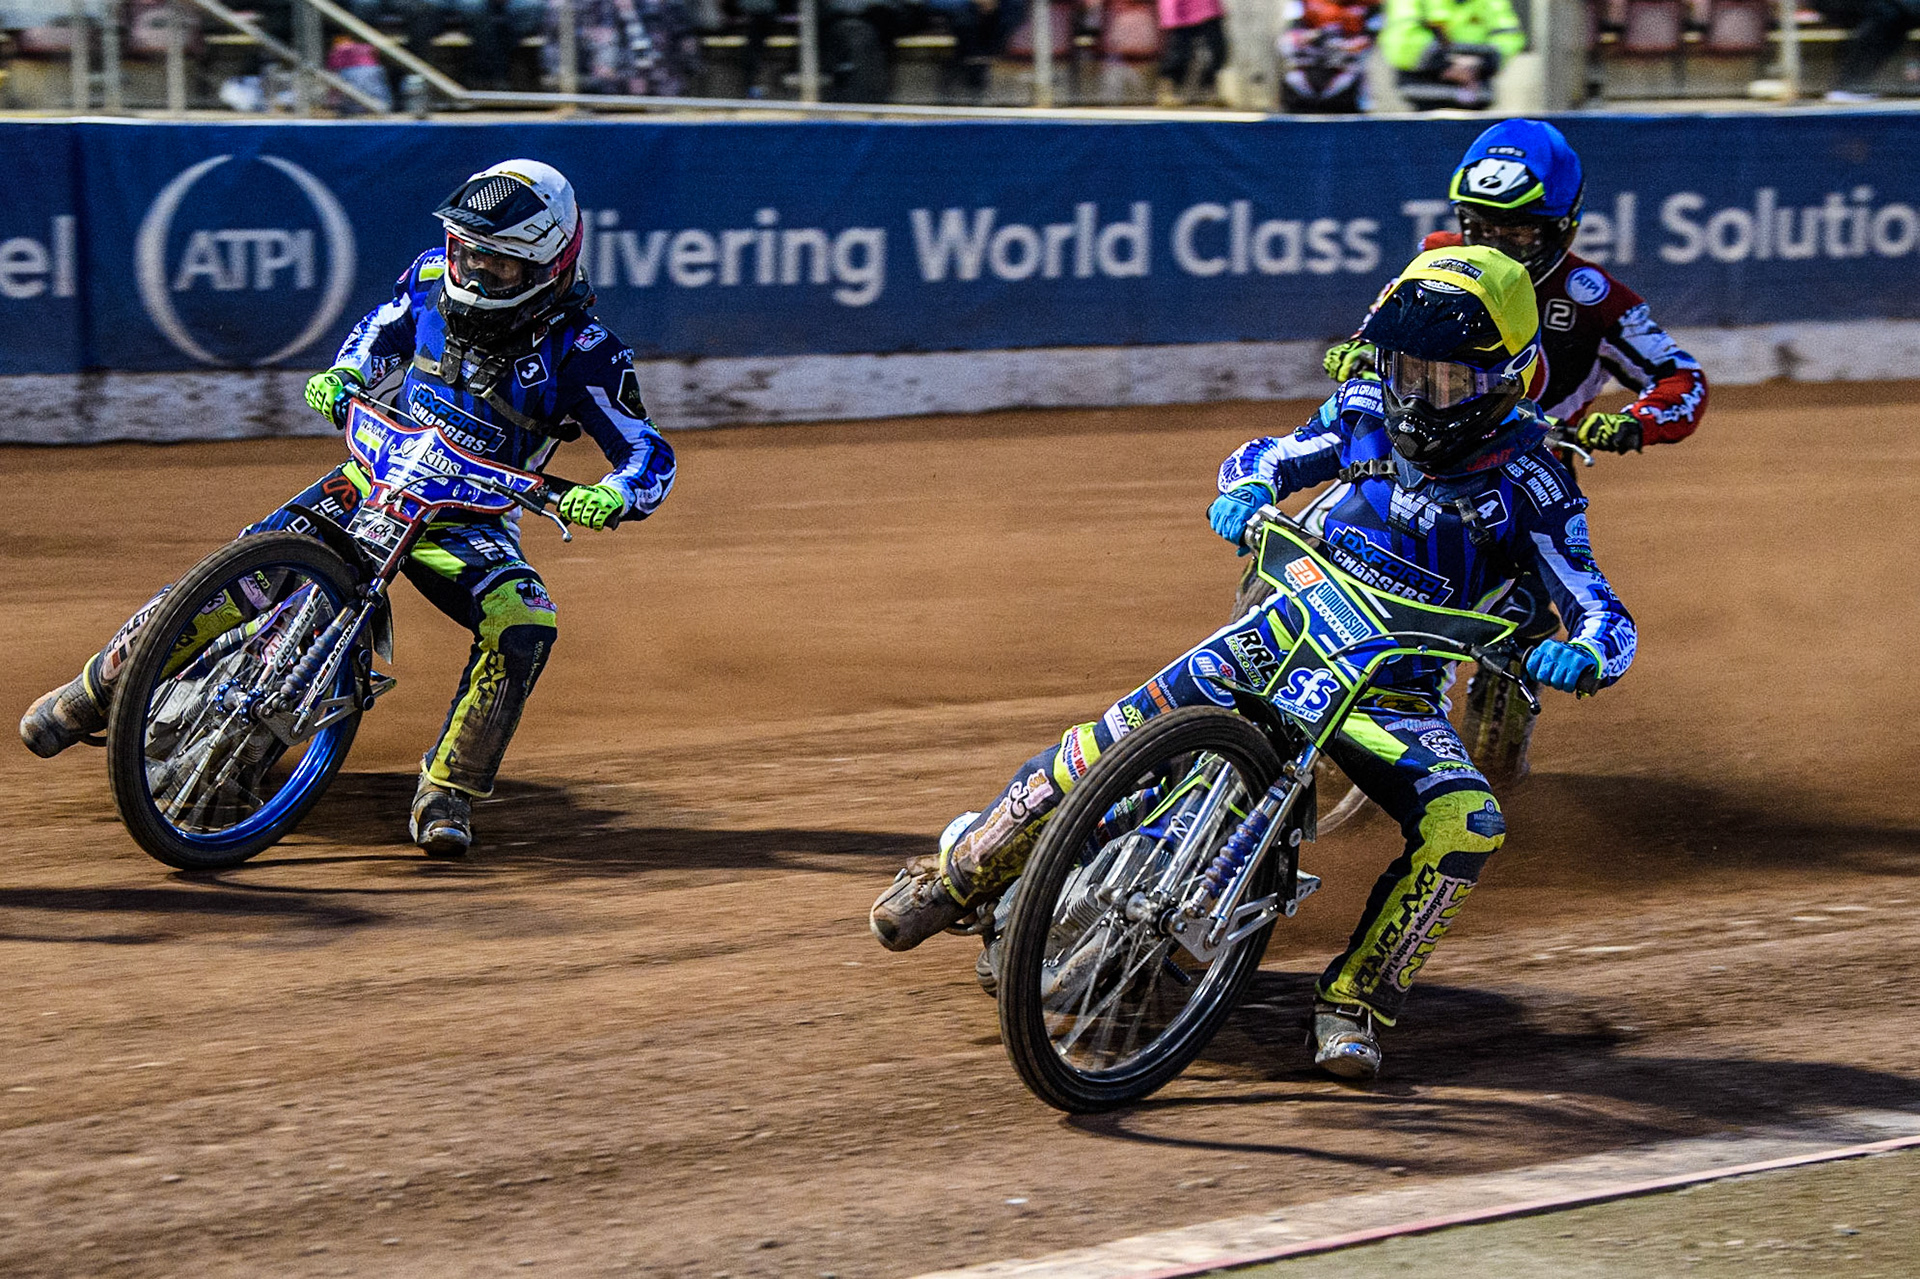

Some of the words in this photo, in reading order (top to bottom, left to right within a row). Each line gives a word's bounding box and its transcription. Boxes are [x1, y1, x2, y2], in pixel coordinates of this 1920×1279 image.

[172, 230, 314, 291] ATPI
[578, 207, 887, 307] livering
[909, 201, 1151, 282] World
[1172, 199, 1380, 277] Class
[1550, 304, 1571, 326] 2
[521, 362, 540, 380] 3
[412, 401, 487, 452] CHARGERS
[416, 388, 497, 440] OXFORD
[1517, 455, 1538, 475] RLEY
[1477, 500, 1499, 519] 4
[1526, 477, 1553, 507] BONDY
[1333, 550, 1430, 603] CHARGERS
[1343, 533, 1441, 592] OXFORD
[1309, 594, 1350, 642] ELECTRICA
[1316, 581, 1369, 642] EDMUNDSON
[1414, 880, 1454, 931] Landscape
[1395, 931, 1420, 961] Centre
